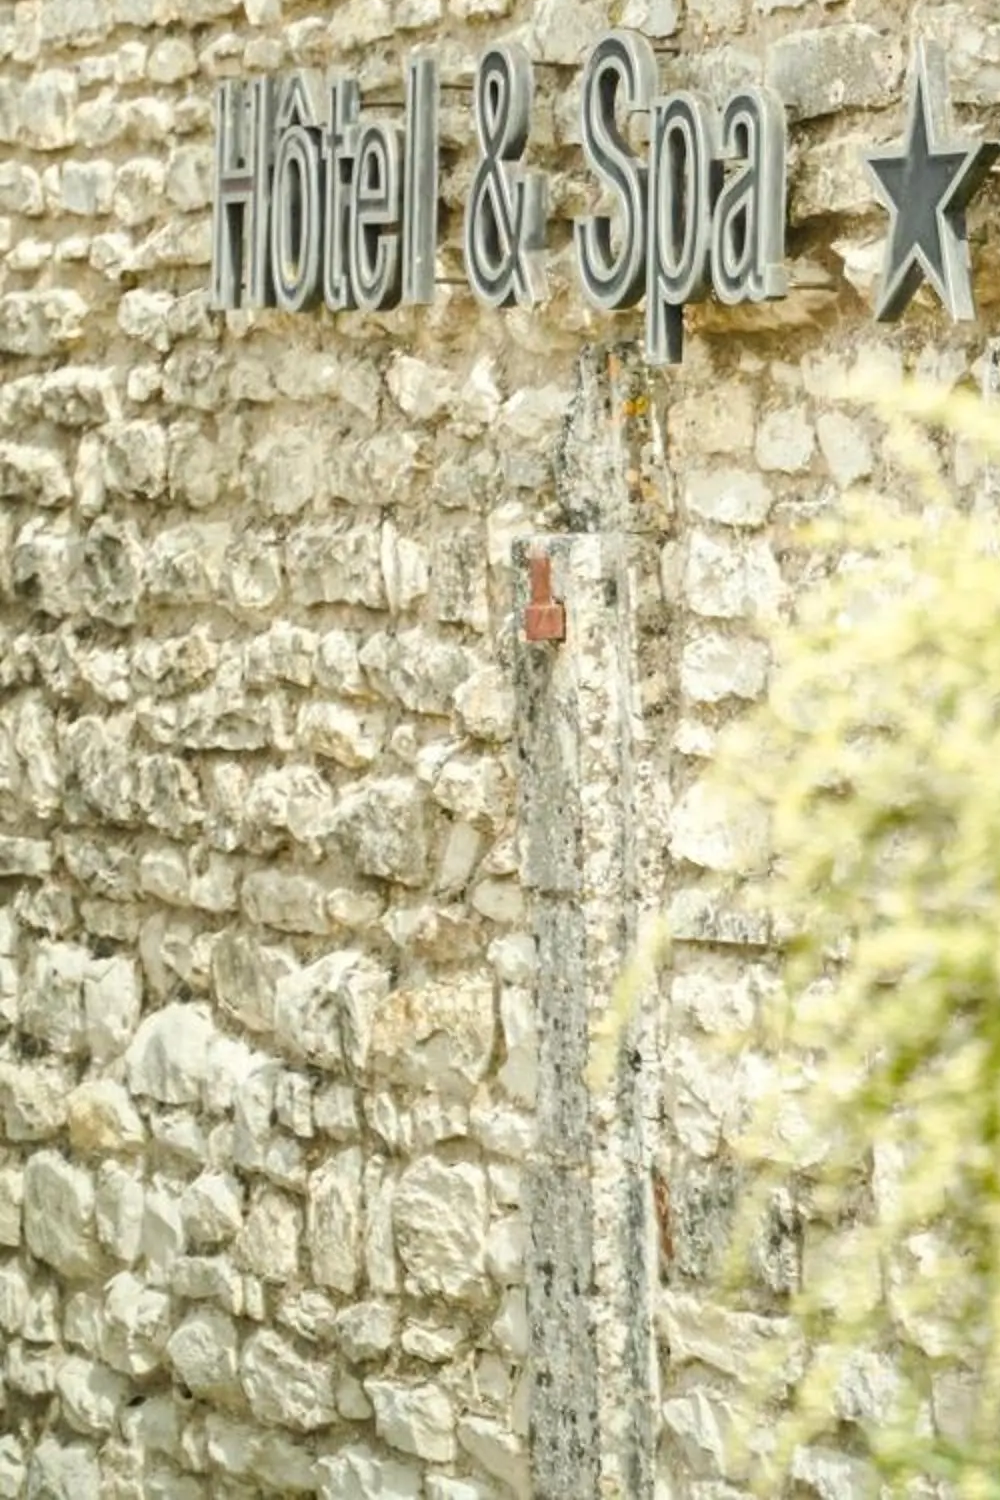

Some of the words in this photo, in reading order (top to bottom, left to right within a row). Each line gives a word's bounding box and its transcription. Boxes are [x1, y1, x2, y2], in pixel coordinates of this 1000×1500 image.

[211, 54, 439, 312] Hôtel
[464, 40, 550, 308] &
[574, 27, 789, 365] Spa
